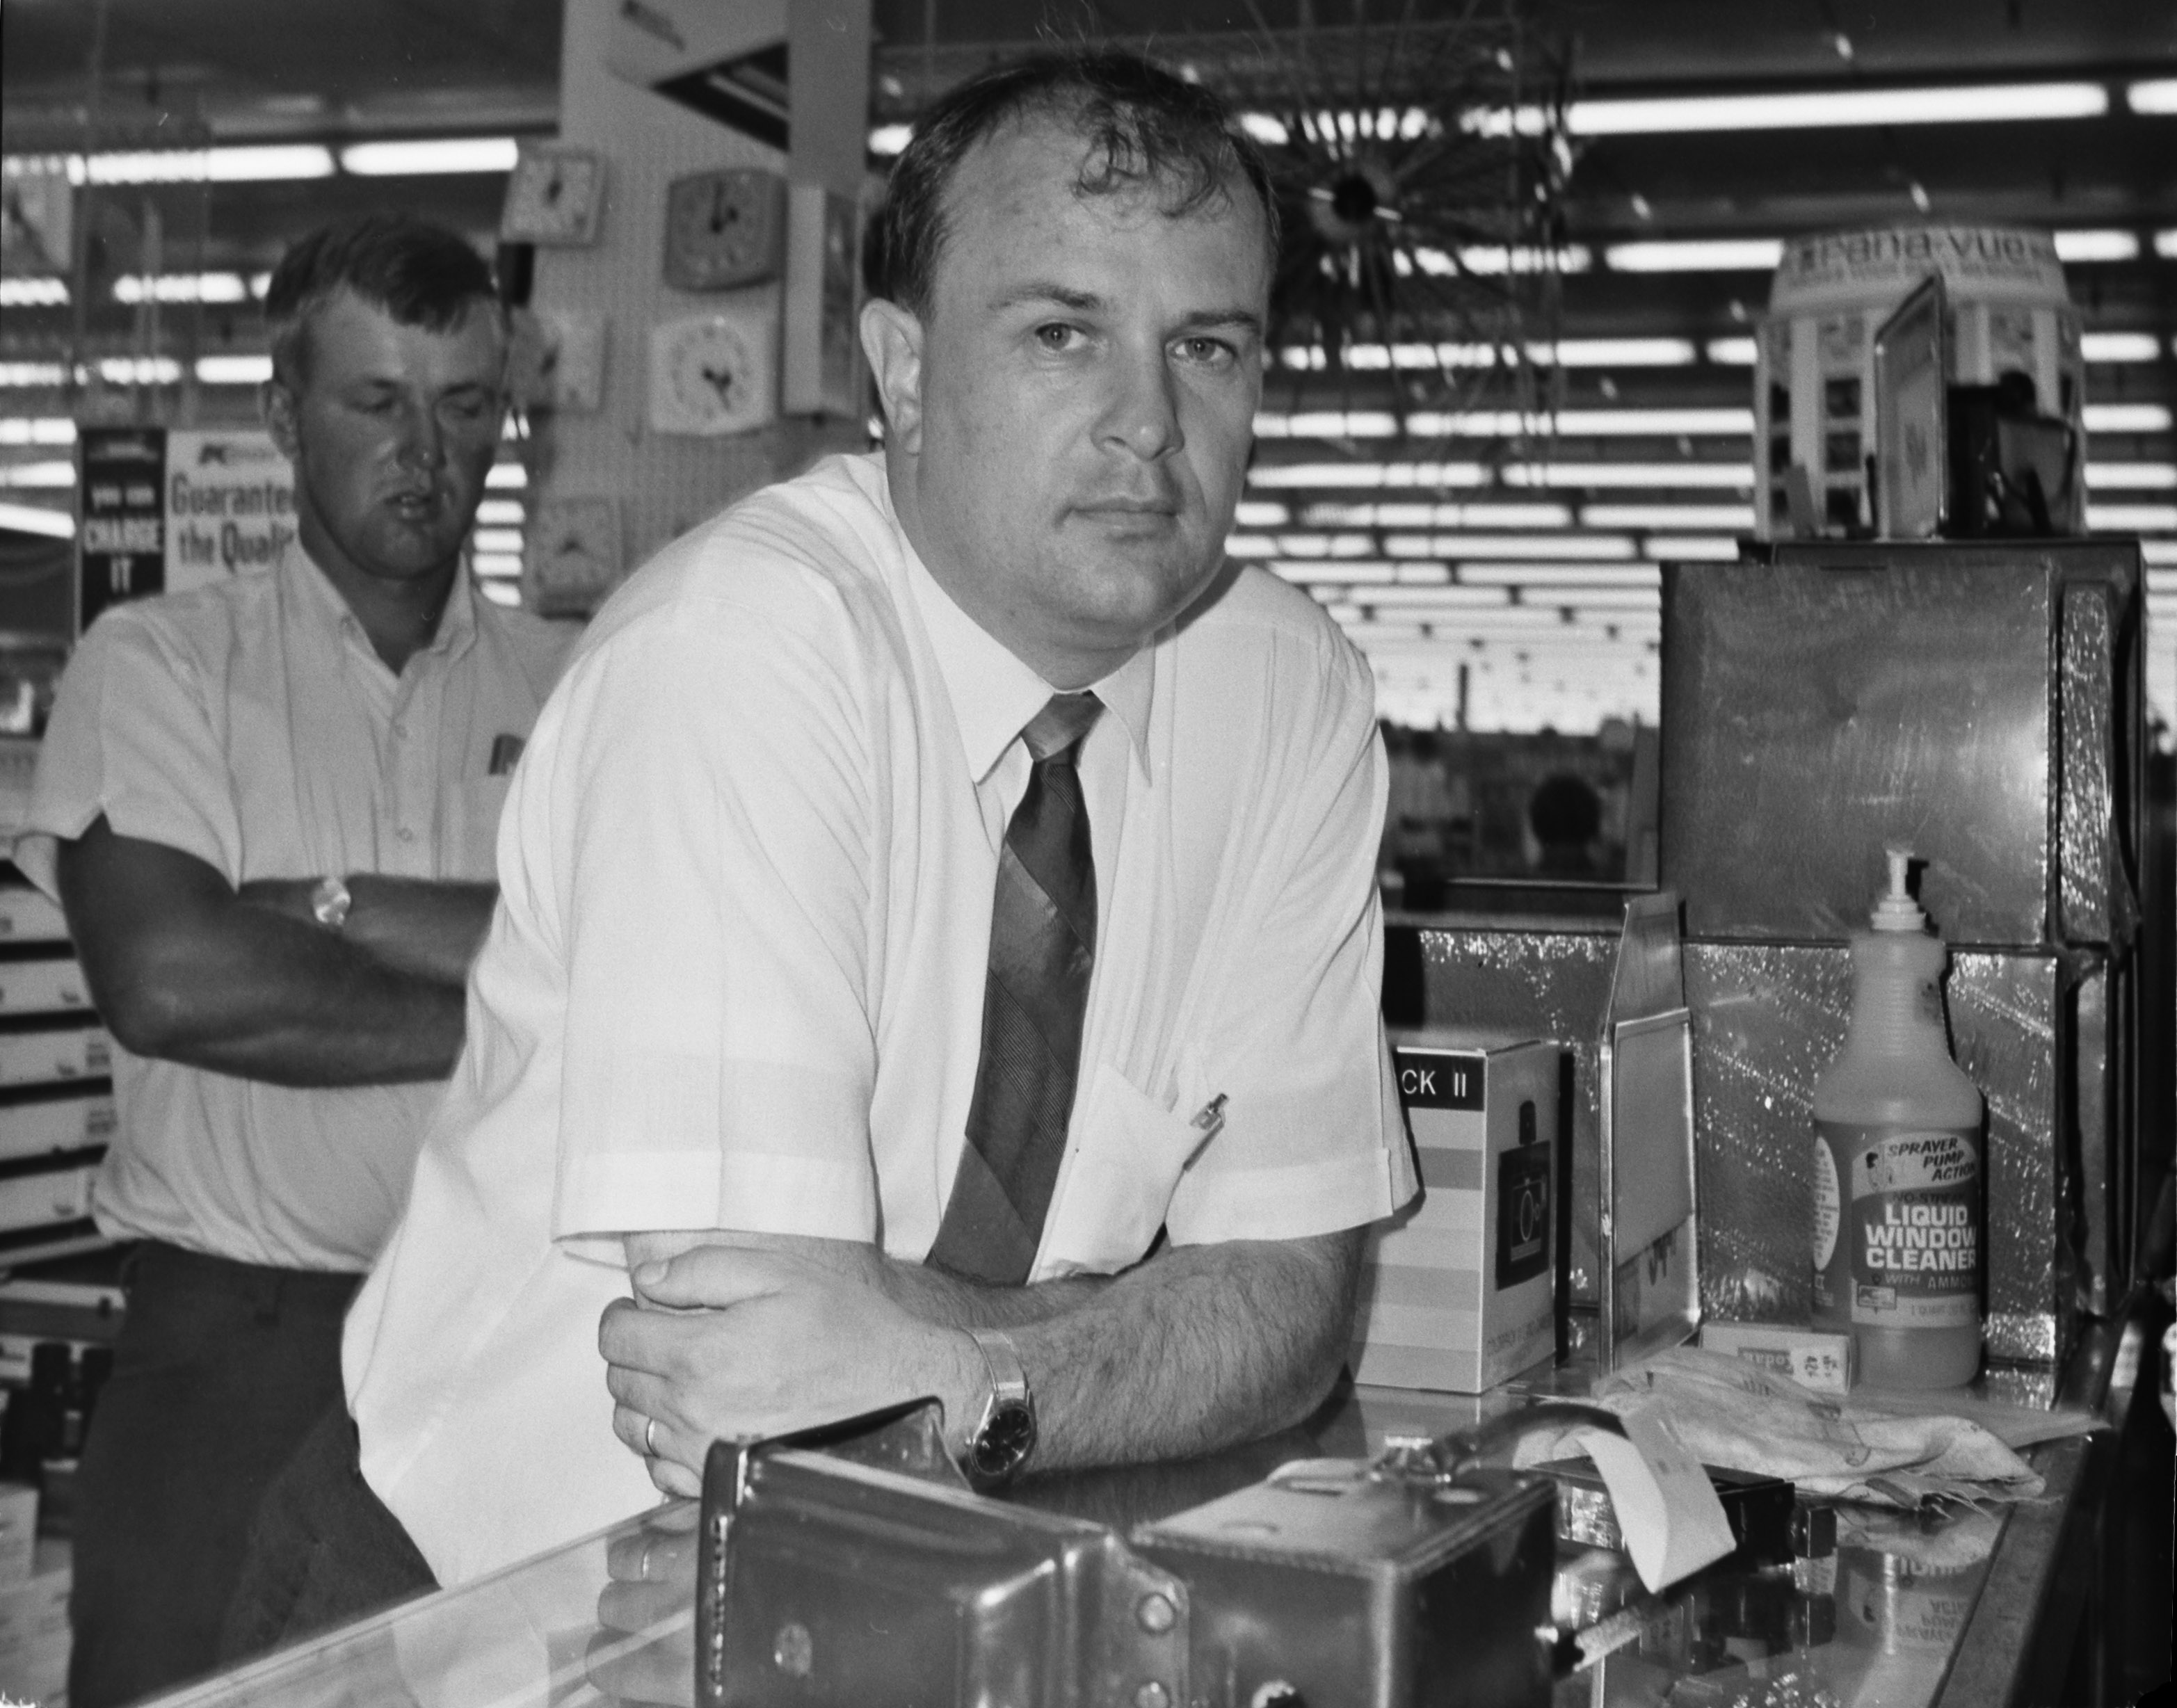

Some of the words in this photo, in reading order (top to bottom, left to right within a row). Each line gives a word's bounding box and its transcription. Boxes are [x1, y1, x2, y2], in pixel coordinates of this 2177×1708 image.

[1401, 1069, 1436, 1096] CK
[1887, 1137, 1958, 1157] SPRAYER
[1923, 1150, 1965, 1169] PUMP
[1885, 1204, 1968, 1226] LIQUID
[1865, 1224, 1977, 1248] WINDOW
[1866, 1248, 1976, 1271] CLEANER
[1885, 1273, 1920, 1285] WITH
